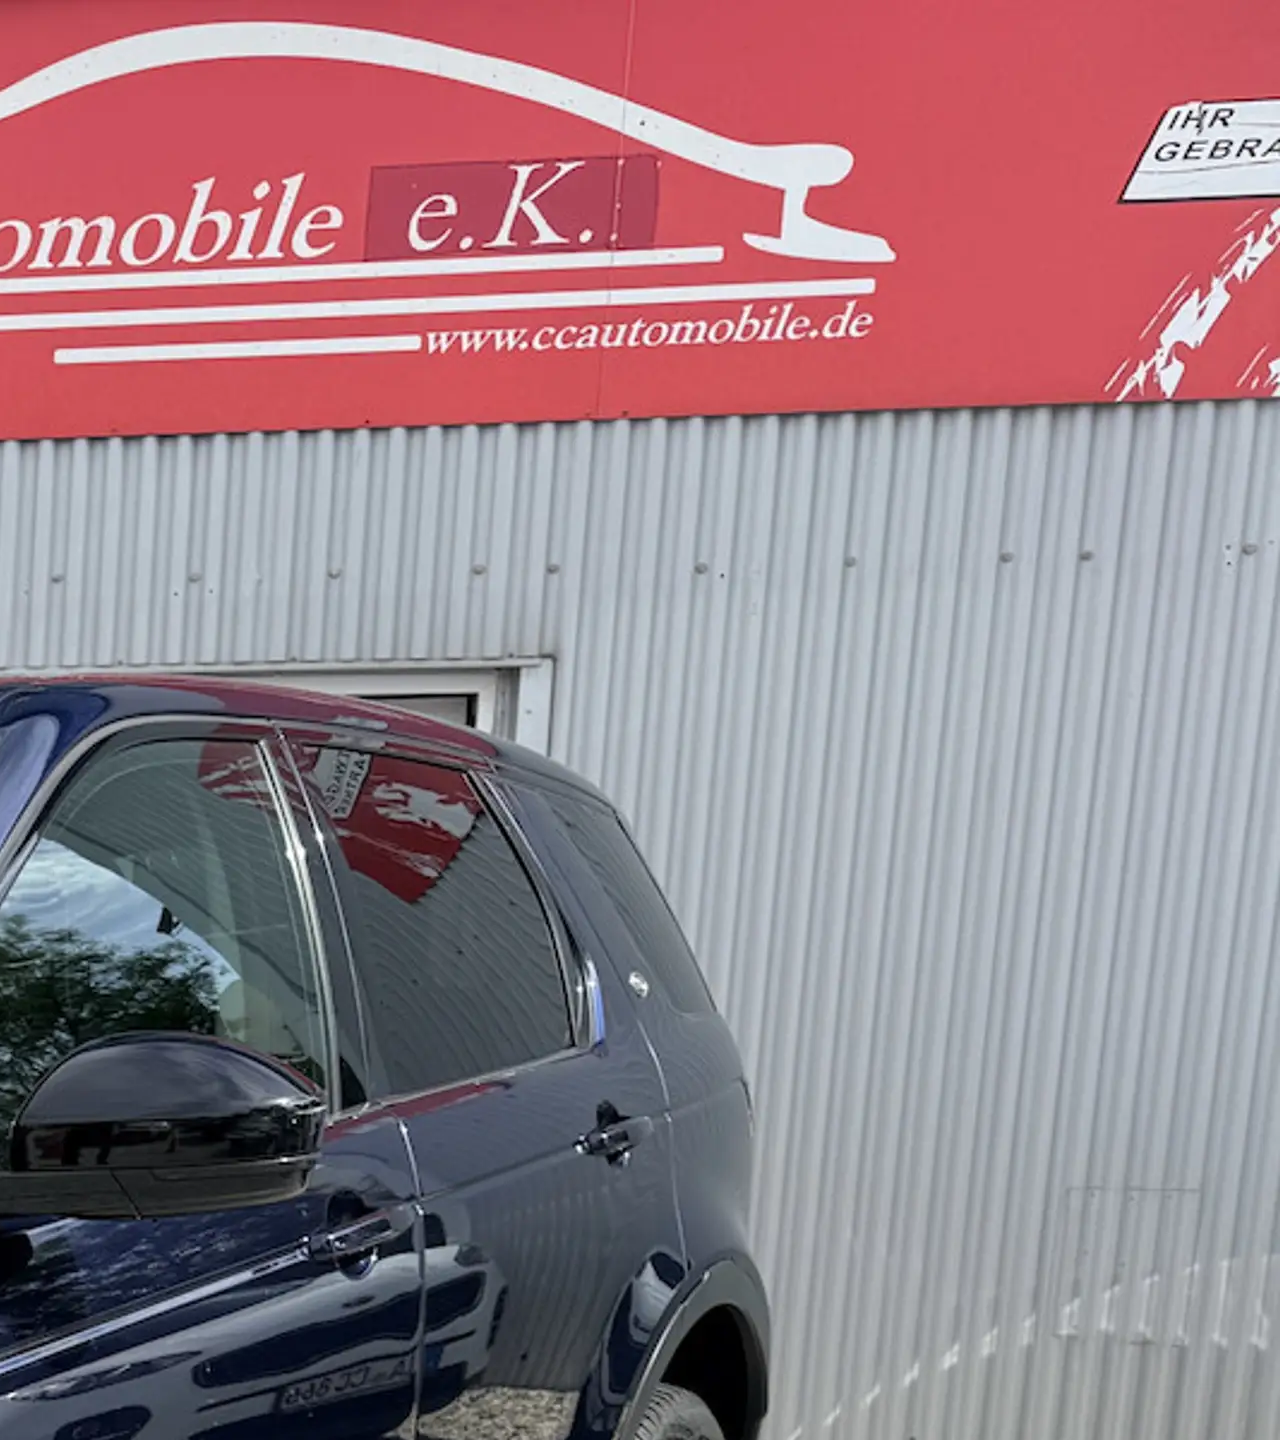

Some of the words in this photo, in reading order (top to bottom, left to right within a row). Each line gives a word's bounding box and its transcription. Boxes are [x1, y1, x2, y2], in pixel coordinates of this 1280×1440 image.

[1167, 108, 1236, 131] IHR
[407, 159, 594, 253] e.K.
[426, 300, 874, 355] www.ccautomobile.de
